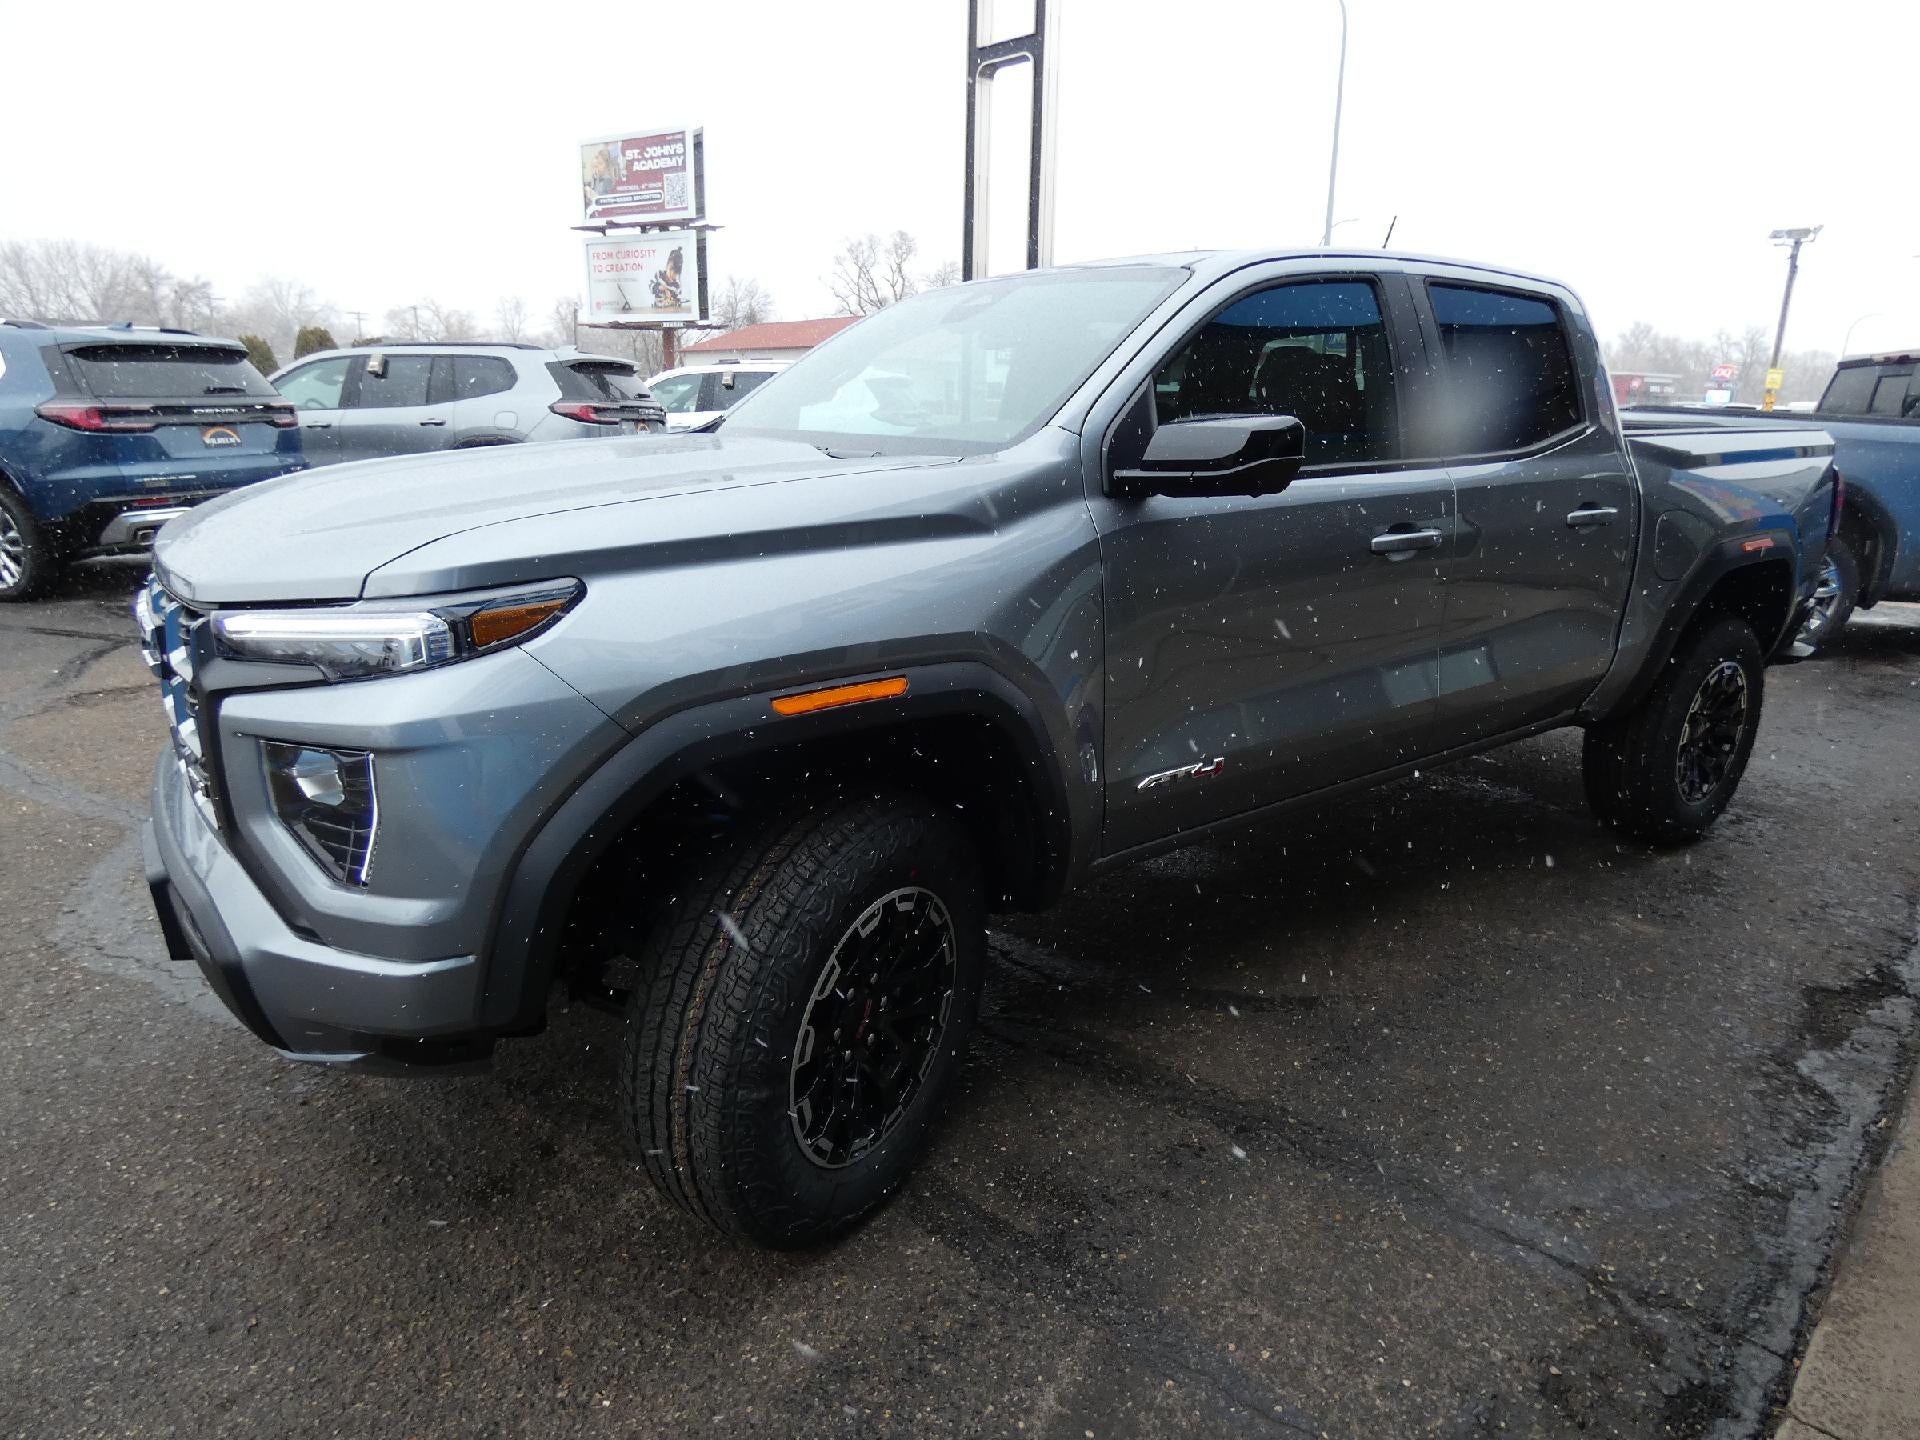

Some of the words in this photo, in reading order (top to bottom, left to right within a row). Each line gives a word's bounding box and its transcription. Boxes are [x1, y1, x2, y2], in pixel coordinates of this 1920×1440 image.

[625, 149, 641, 160] ST.
[644, 143, 684, 158] JOHN'S
[633, 156, 684, 171] ACADEMY
[592, 250, 614, 261] FROM
[615, 248, 656, 260] CURIOSITY
[593, 264, 603, 273] TO
[605, 262, 643, 273] CREATION
